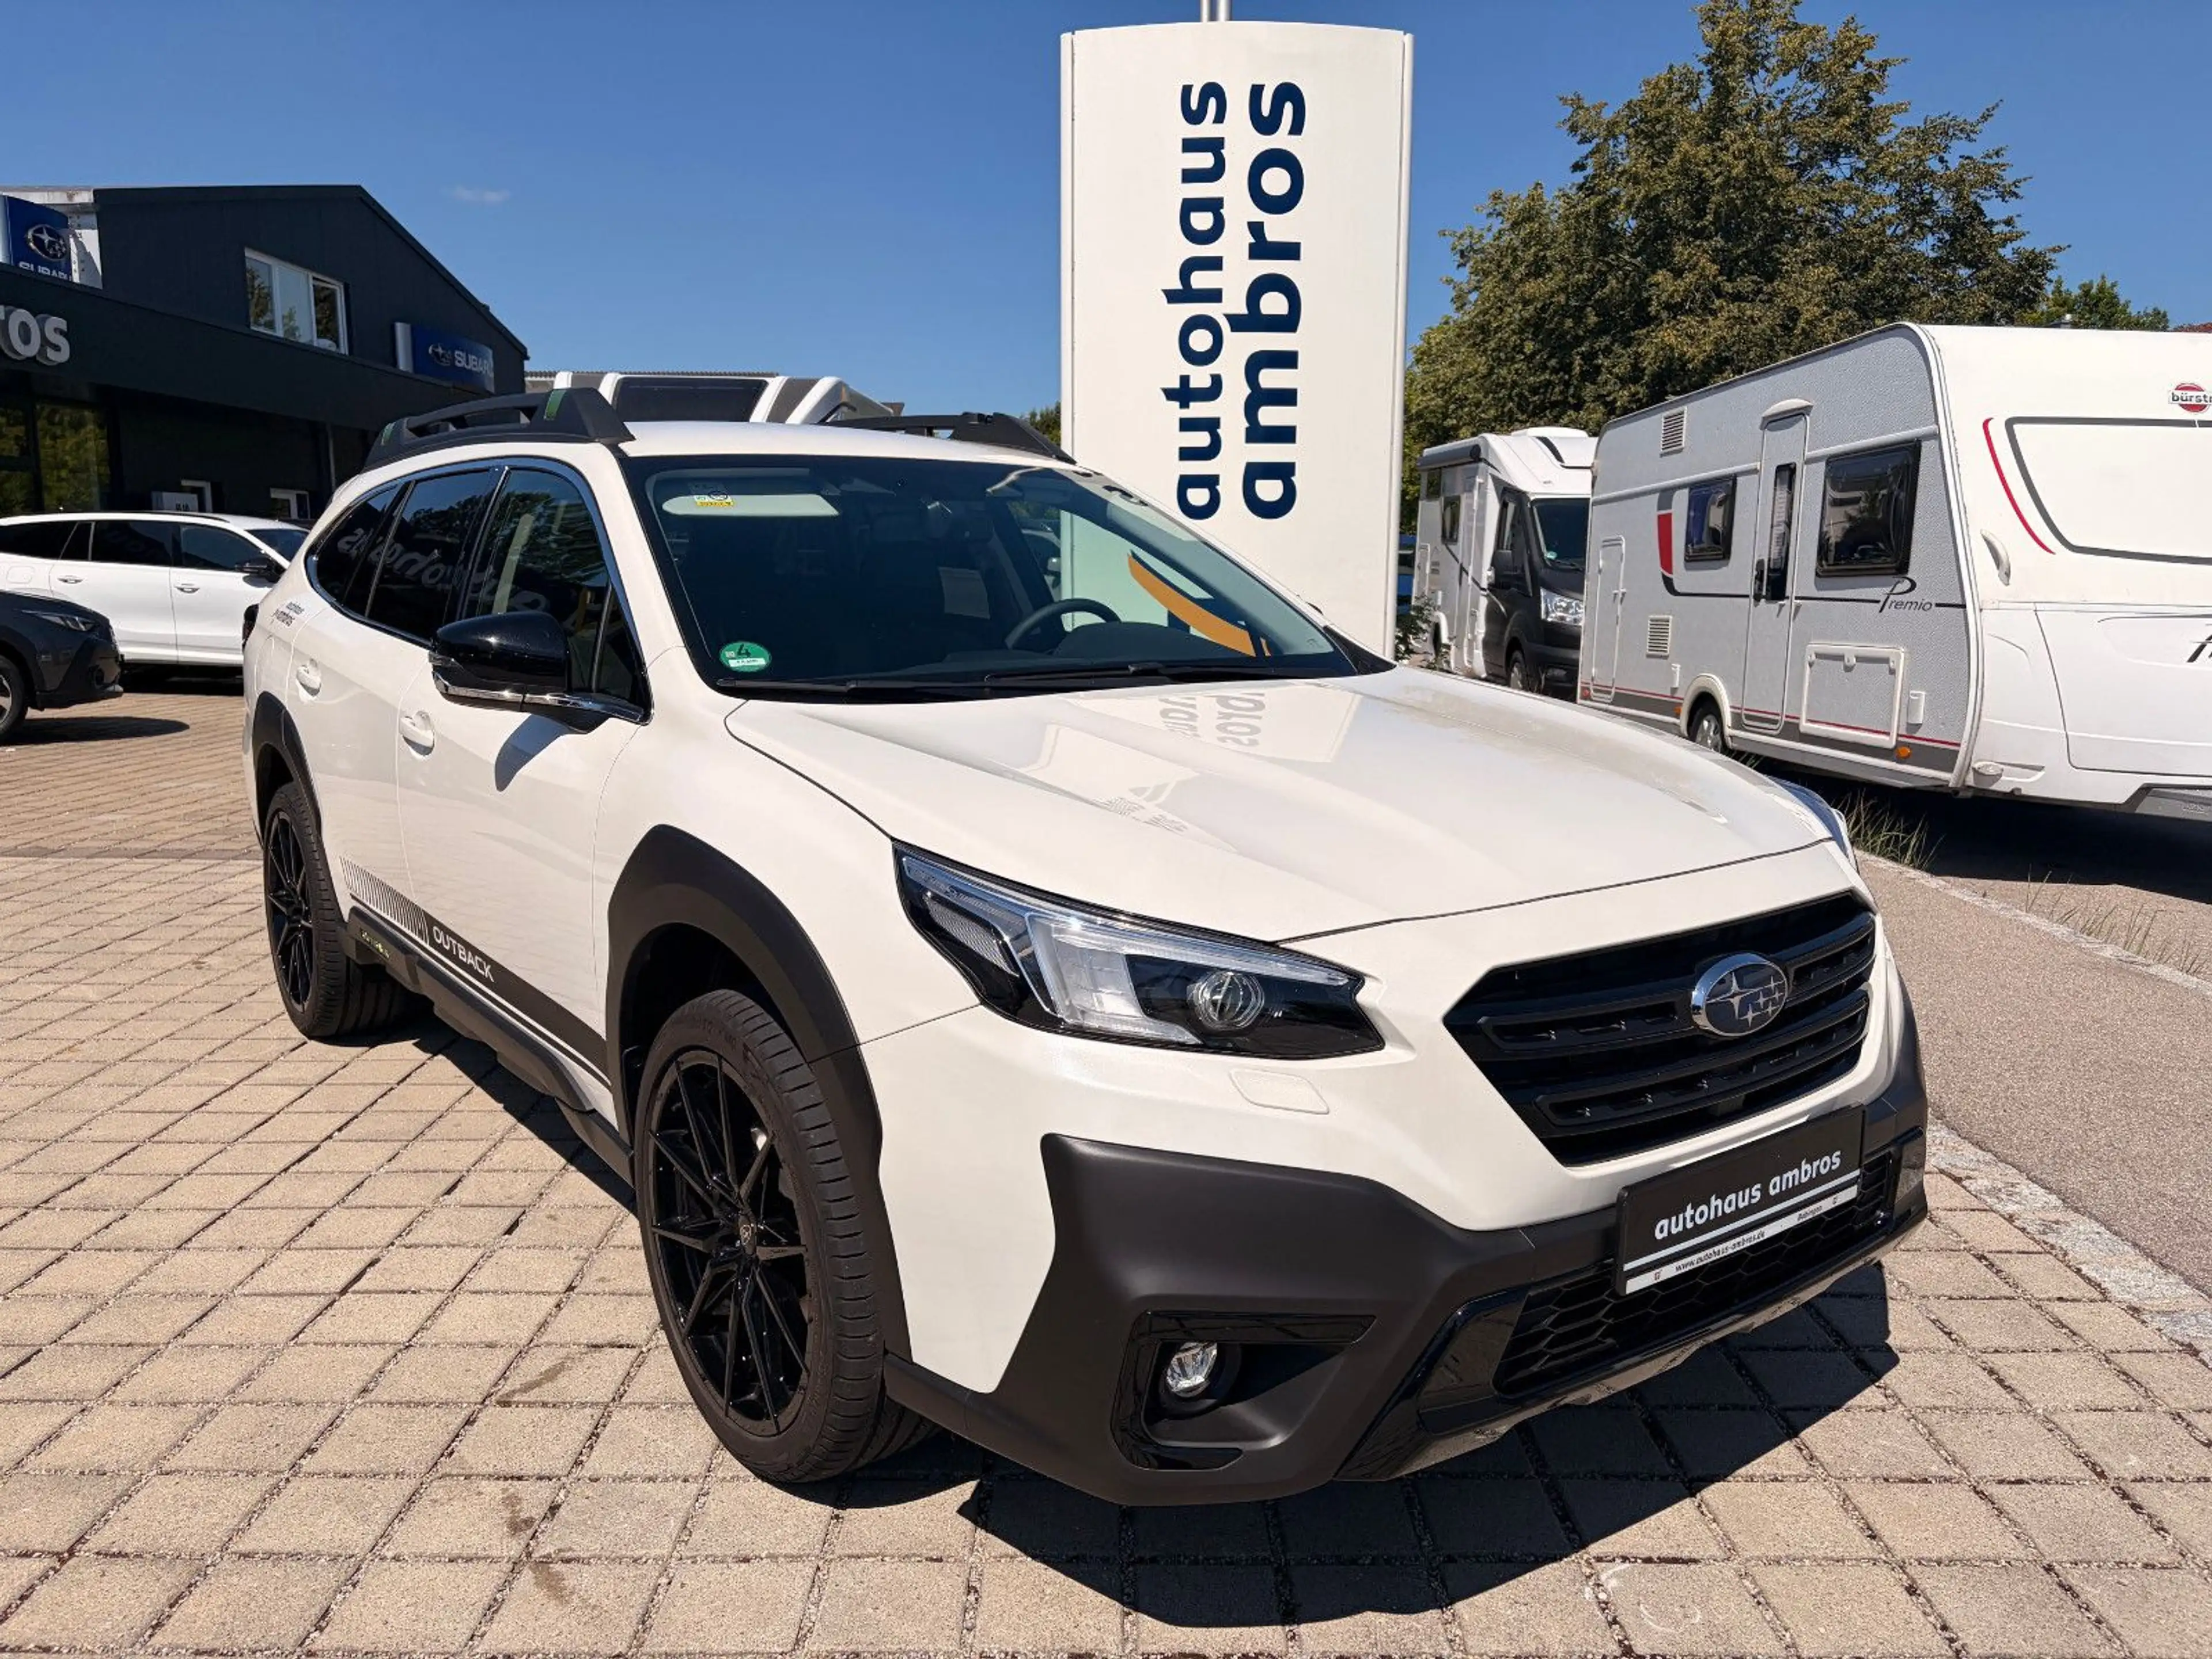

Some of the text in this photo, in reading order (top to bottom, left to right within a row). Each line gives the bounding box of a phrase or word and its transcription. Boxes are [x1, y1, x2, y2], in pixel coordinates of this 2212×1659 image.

[1161, 81, 1227, 521] autohaus
[1224, 81, 1306, 520] ambros
[0, 305, 70, 363] os
[1879, 576, 1933, 613] Premio
[737, 643, 751, 657] 4
[433, 926, 494, 982] OUTBACK
[1654, 1150, 1841, 1240] autohaus ambros
